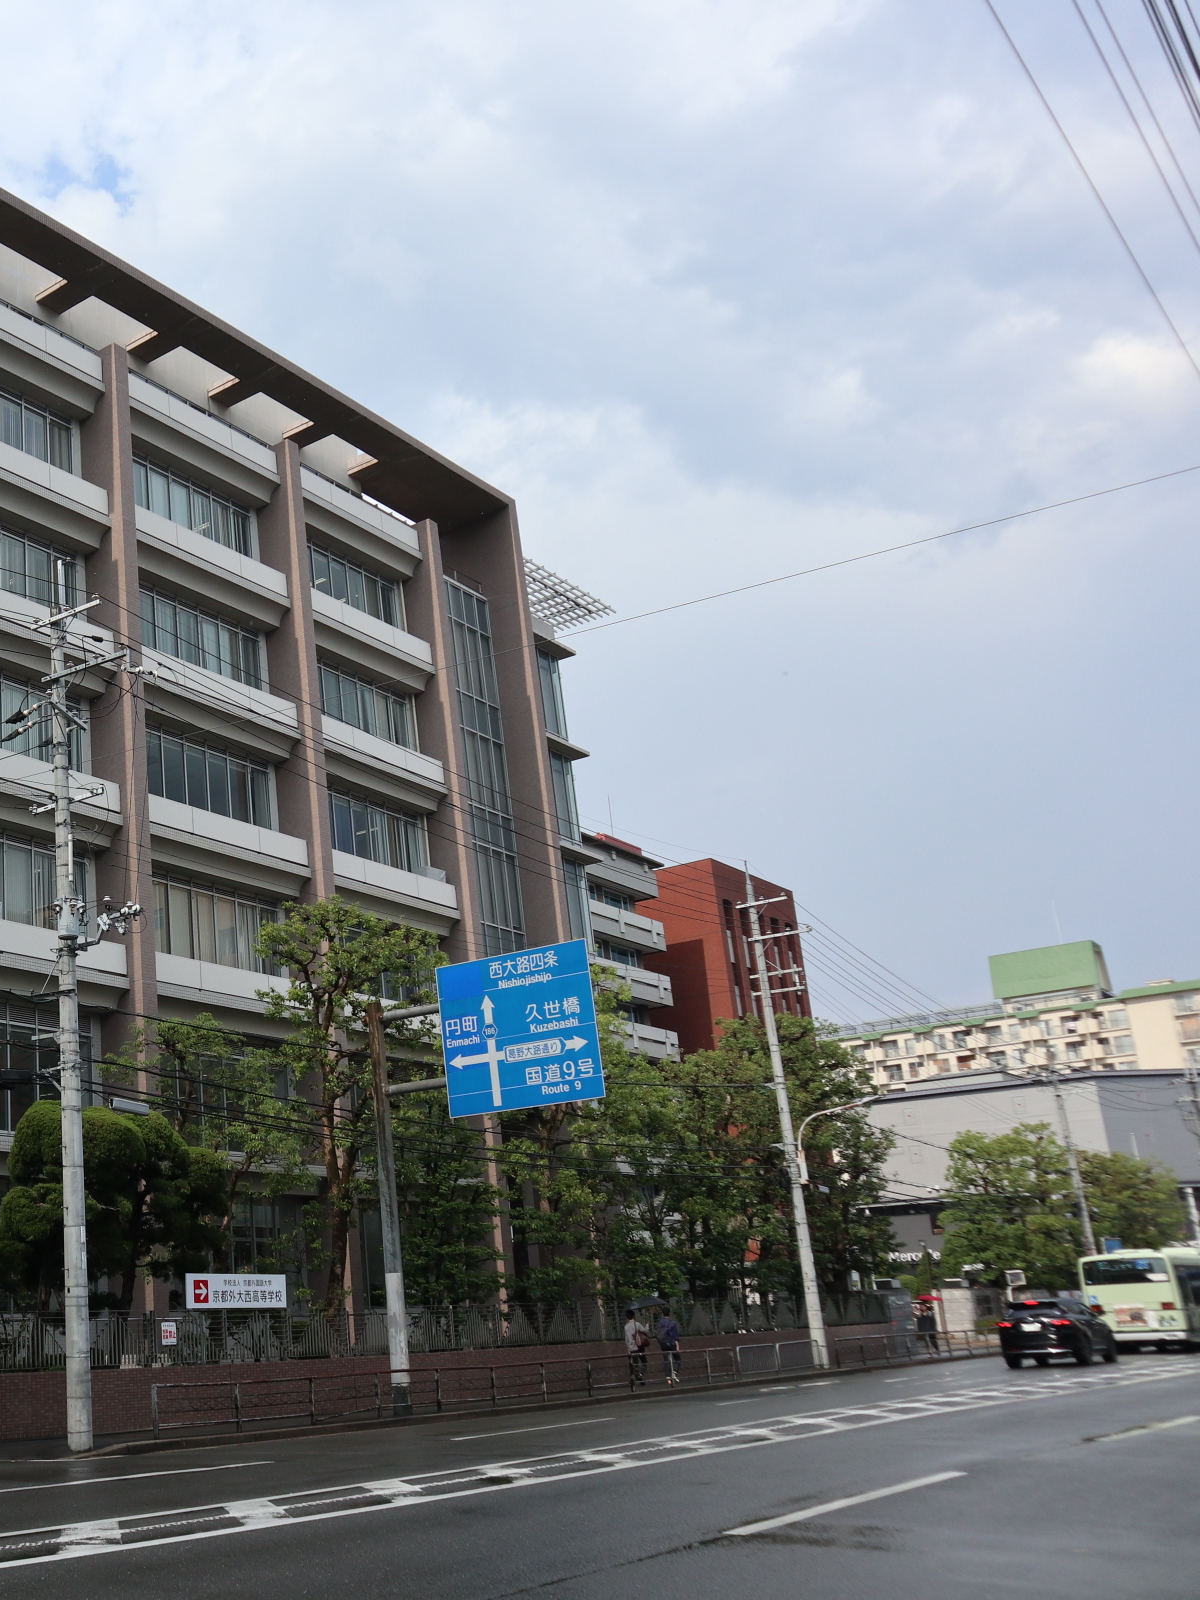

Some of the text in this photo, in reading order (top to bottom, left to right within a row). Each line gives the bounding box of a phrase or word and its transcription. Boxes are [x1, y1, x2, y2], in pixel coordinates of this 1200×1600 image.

[488, 950, 558, 979] 西大路四条
[498, 972, 552, 989] Nishiojishijo
[525, 996, 580, 1022] 久世橋
[445, 1015, 478, 1037] 円町
[485, 1027, 496, 1035] 186
[530, 1016, 579, 1034] Kuzebashi
[446, 1034, 480, 1048] Enmachi
[525, 1058, 595, 1085] 国道9号
[541, 1080, 582, 1095] Route 9
[212, 1290, 283, 1303] 京都外大西高等学校
